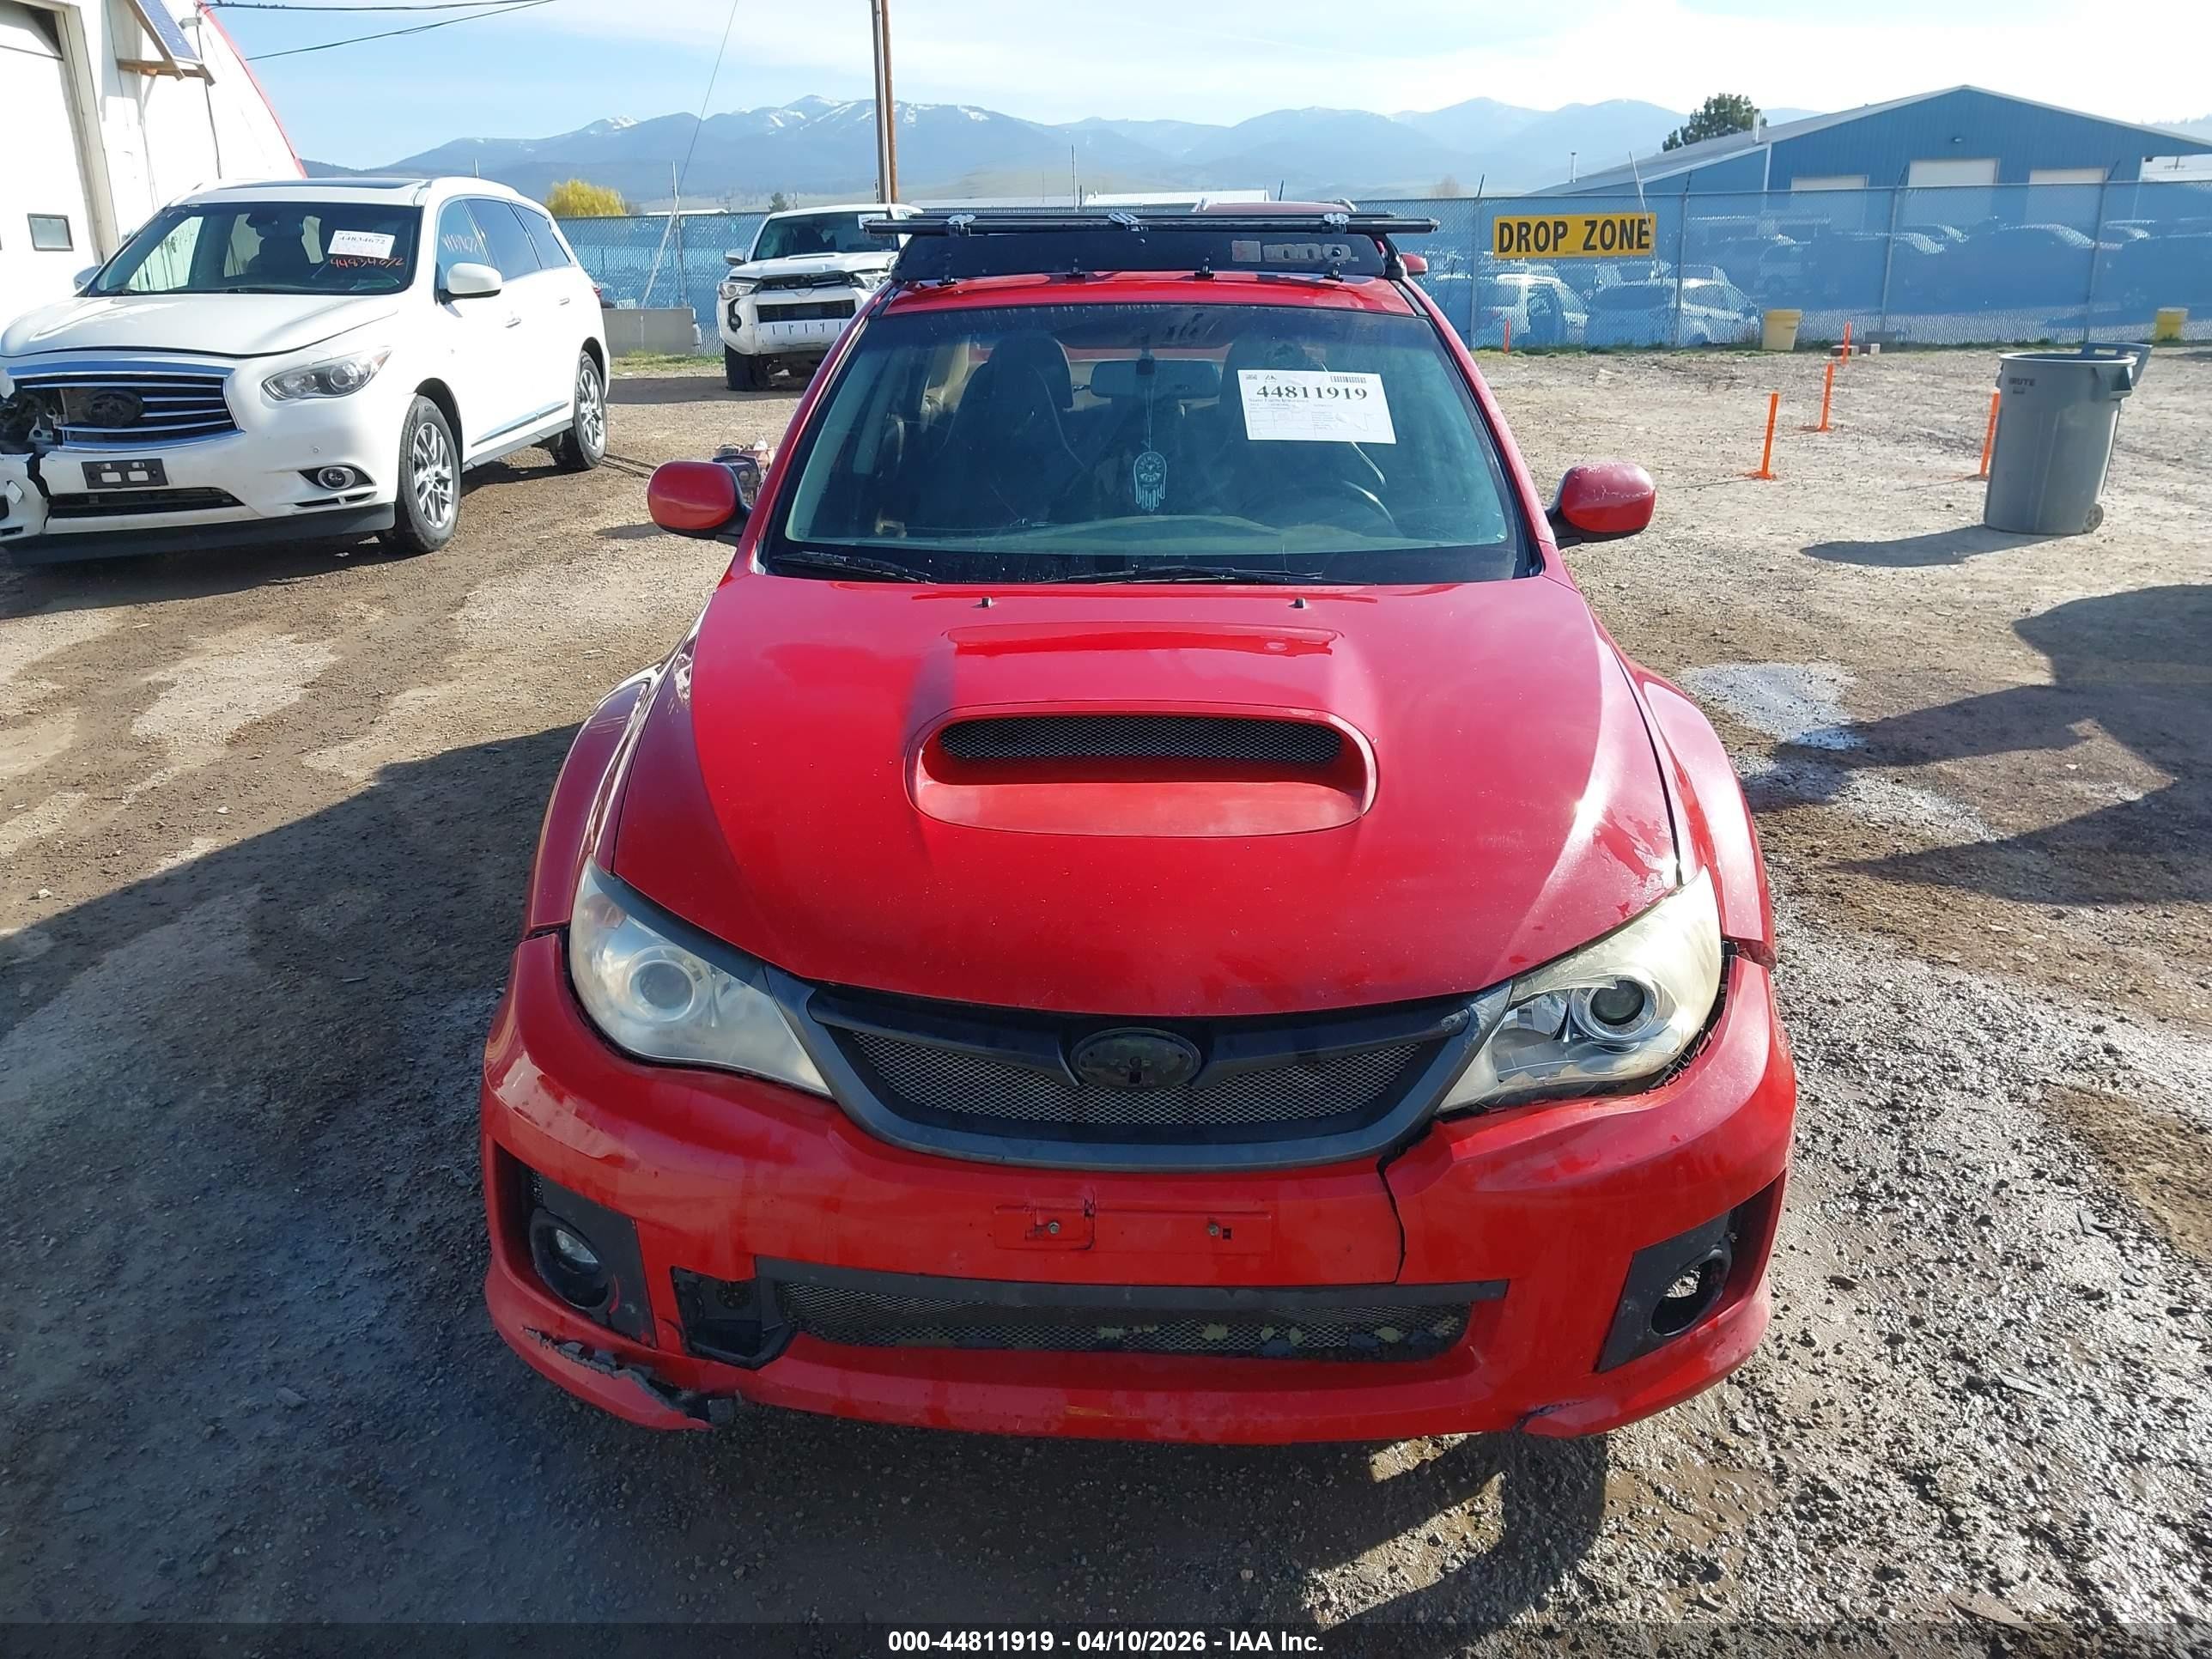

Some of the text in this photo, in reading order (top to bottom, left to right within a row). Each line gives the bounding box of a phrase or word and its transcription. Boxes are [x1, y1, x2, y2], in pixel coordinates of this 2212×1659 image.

[1498, 218, 1650, 253] DROP ZONE
[1256, 385, 1368, 400] 44811919
